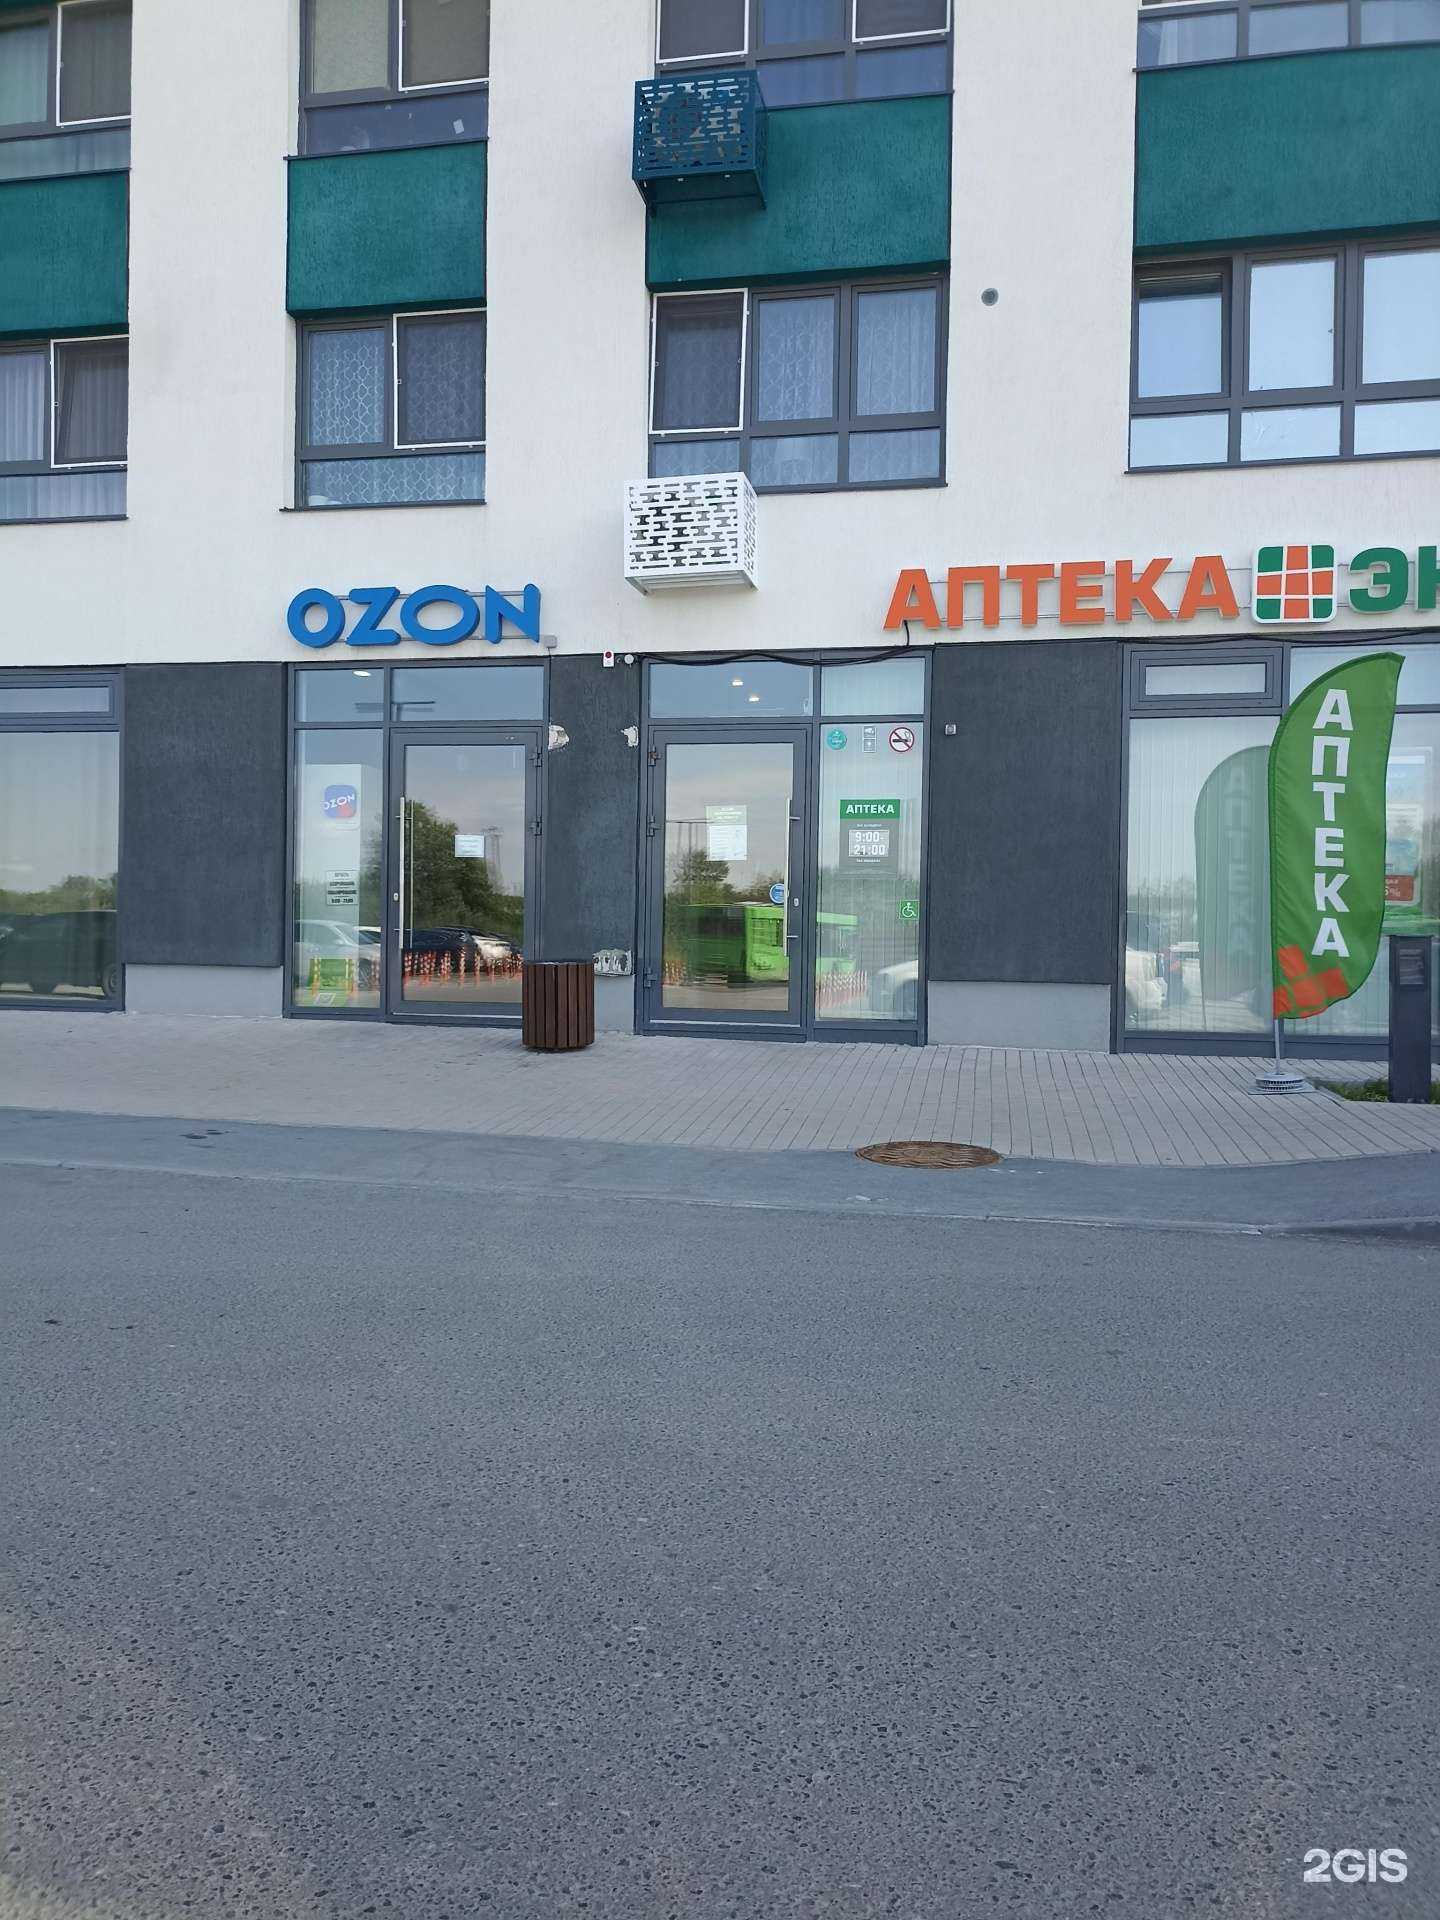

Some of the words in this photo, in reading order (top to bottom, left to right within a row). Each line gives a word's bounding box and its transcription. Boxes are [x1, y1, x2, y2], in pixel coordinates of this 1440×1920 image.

[287, 584, 541, 648] OZON
[883, 555, 1240, 629] АПТЕКА
[845, 804, 895, 814] АПТЕКА
[1310, 688, 1354, 958] АПТЕКА
